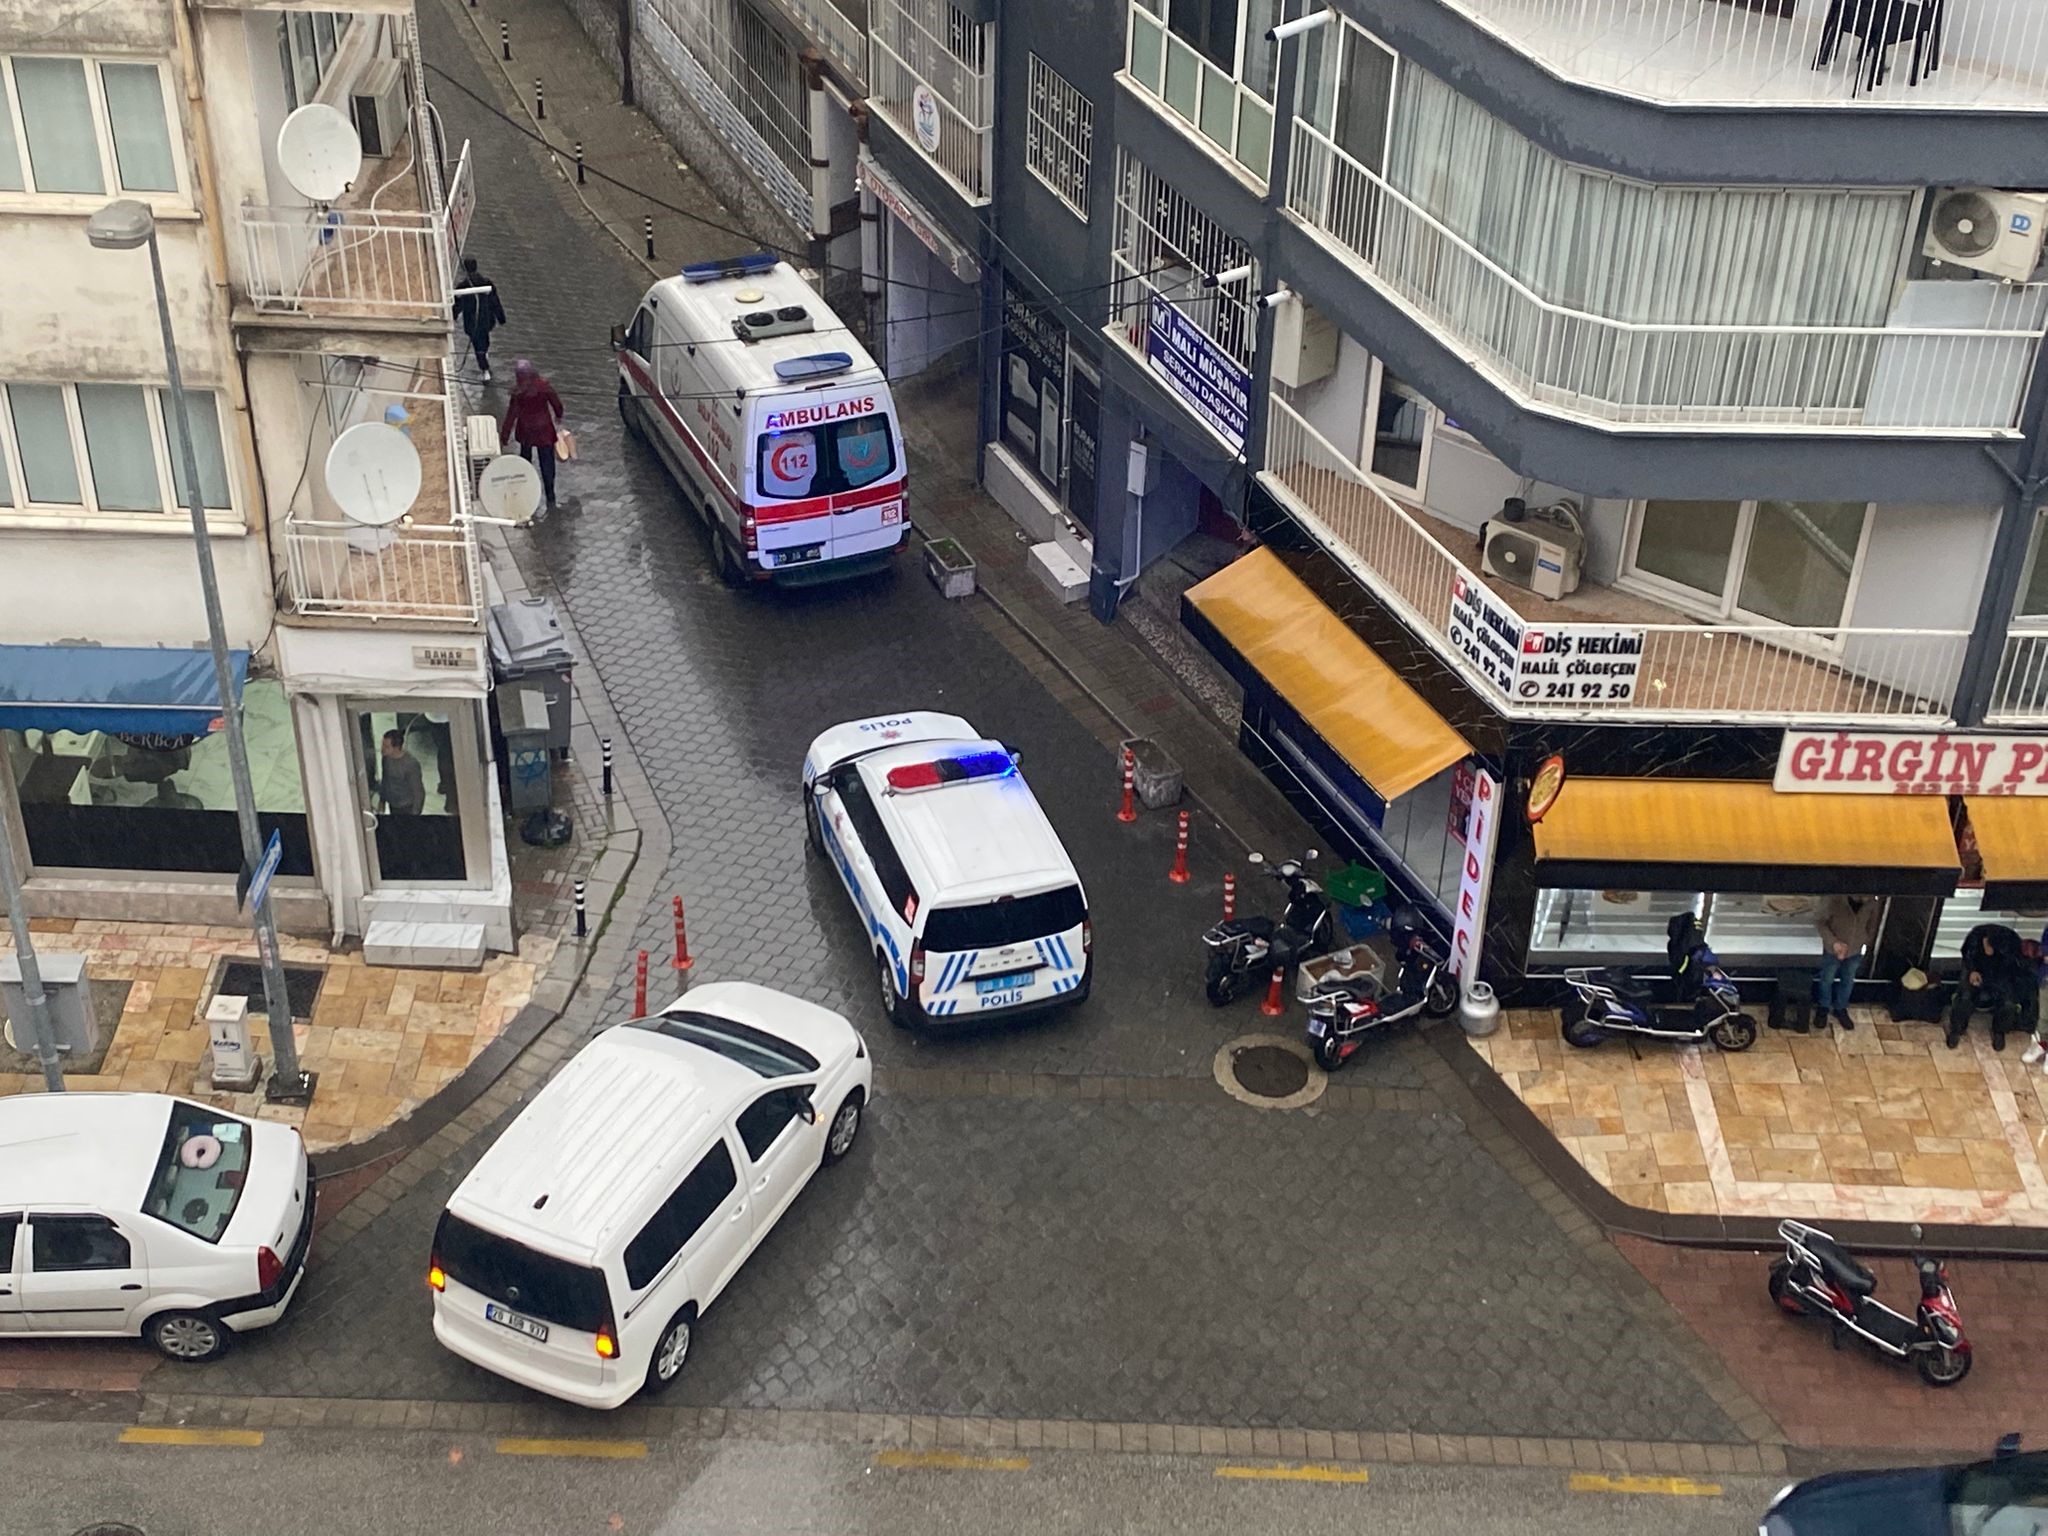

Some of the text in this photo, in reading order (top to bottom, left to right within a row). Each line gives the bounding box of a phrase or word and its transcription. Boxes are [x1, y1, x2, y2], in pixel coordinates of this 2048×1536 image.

[1172, 327, 1248, 411] MALİ MÜŞAVİR
[1163, 350, 1244, 433] SERKAN DAŞIKAN
[765, 397, 875, 429] AMBULANS
[781, 454, 808, 471] 112
[1453, 602, 1515, 671] HALİL ÇÖLGEÇEN
[1465, 588, 1521, 652] DİŞ HEKİMİ
[1544, 631, 1644, 657] DİŞ HEKİMİ
[1463, 637, 1511, 694] 241 92 50
[1521, 657, 1636, 679] HALİL ÇÖLGEÇEN
[1546, 682, 1630, 699] 241 92 50
[858, 717, 913, 731] POLİS
[1790, 731, 1997, 783] GİRGİN
[1455, 773, 1492, 981] PİDECİ
[981, 989, 1024, 1008] POLİS
